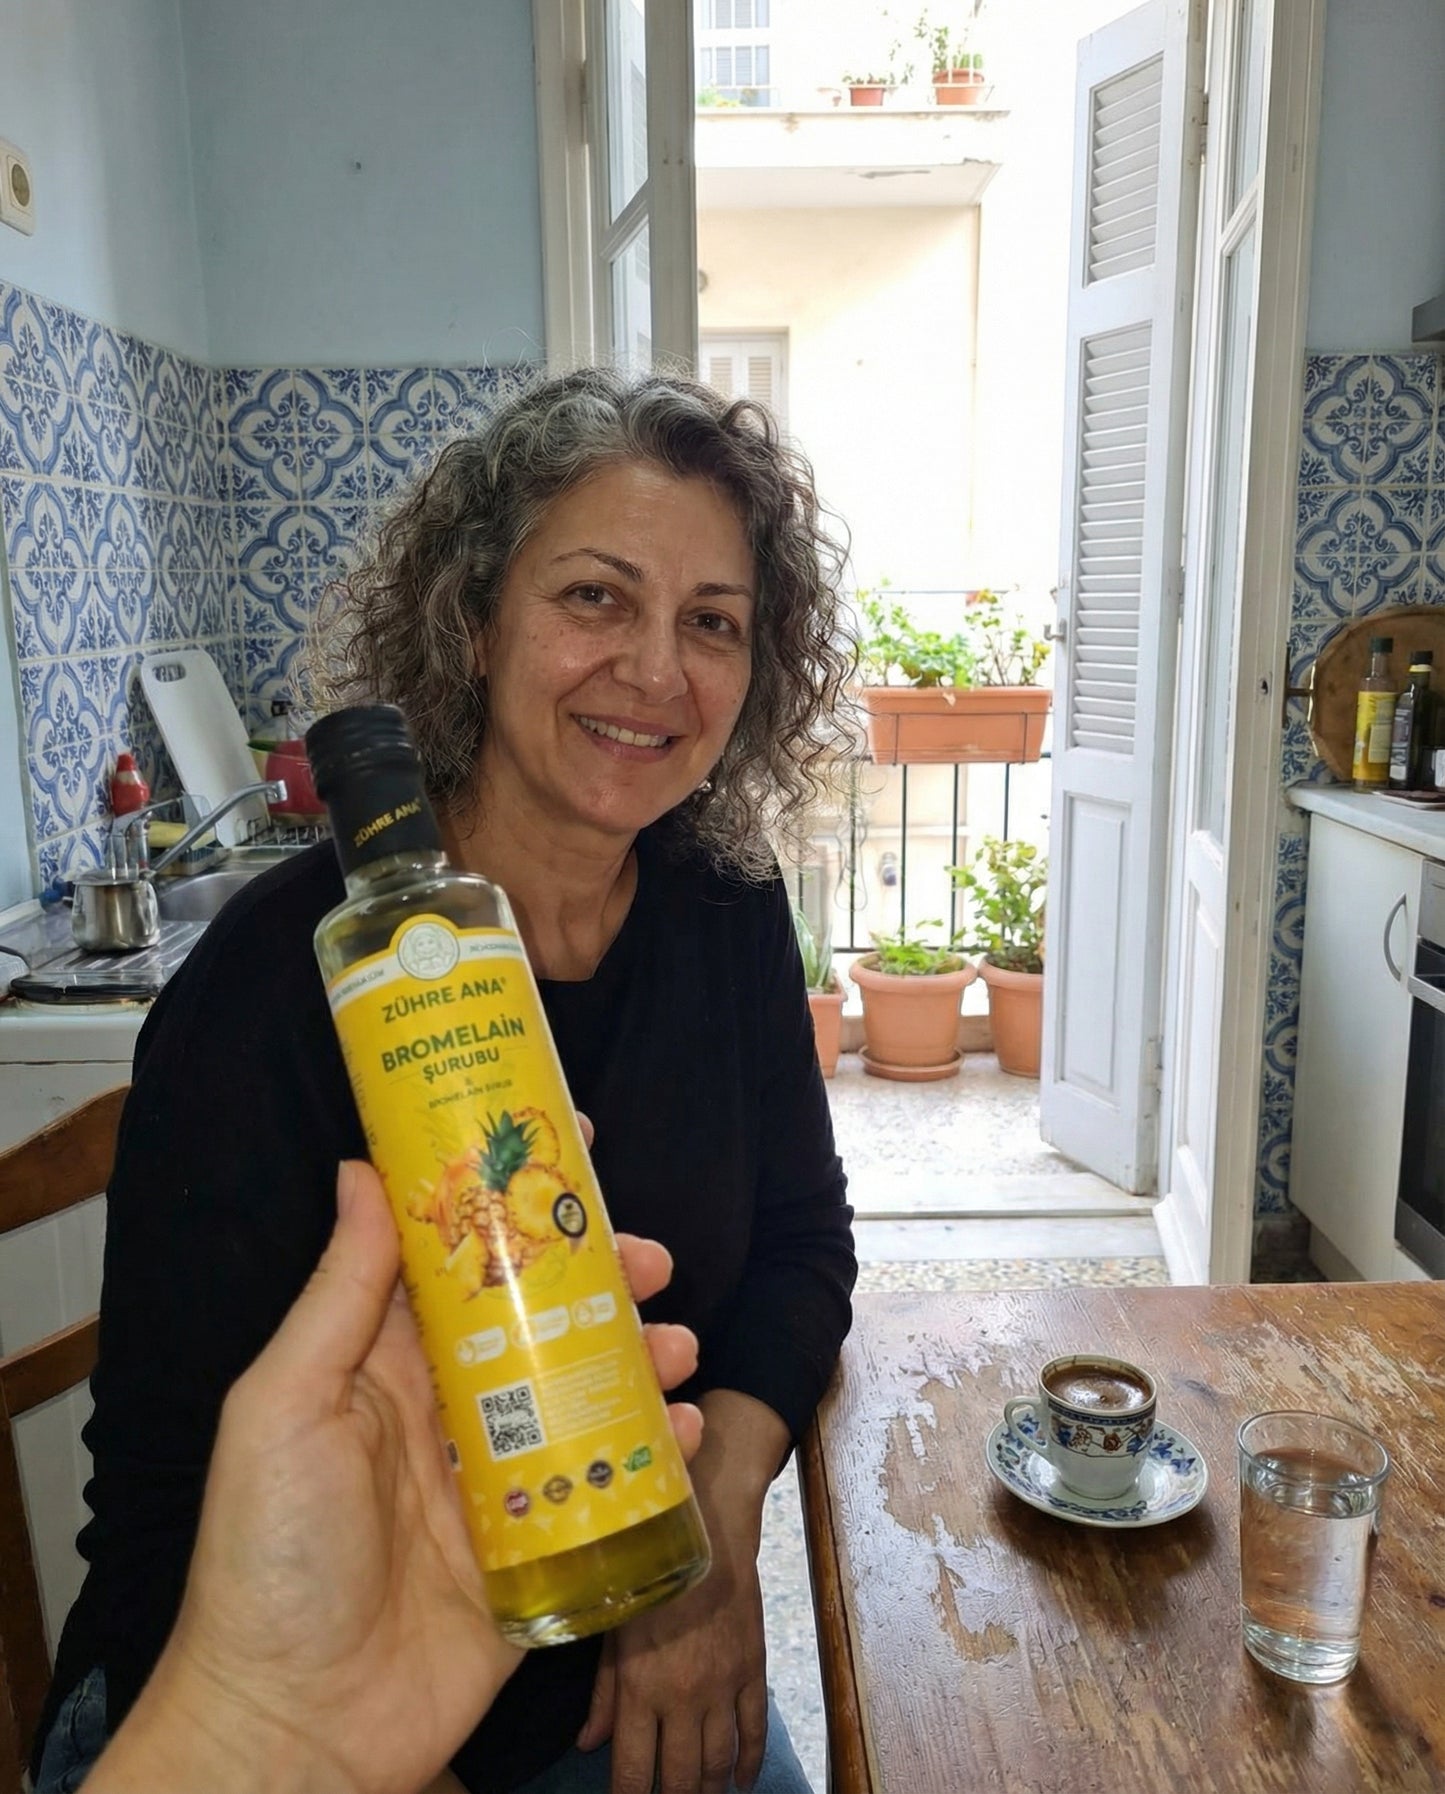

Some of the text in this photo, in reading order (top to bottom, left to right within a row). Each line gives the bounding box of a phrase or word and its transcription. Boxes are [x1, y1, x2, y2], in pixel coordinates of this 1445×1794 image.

[382, 985, 456, 1024] ZÜHRE
[381, 1013, 525, 1073] BROMELAİN
[423, 1047, 500, 1084] ŞURUBU
